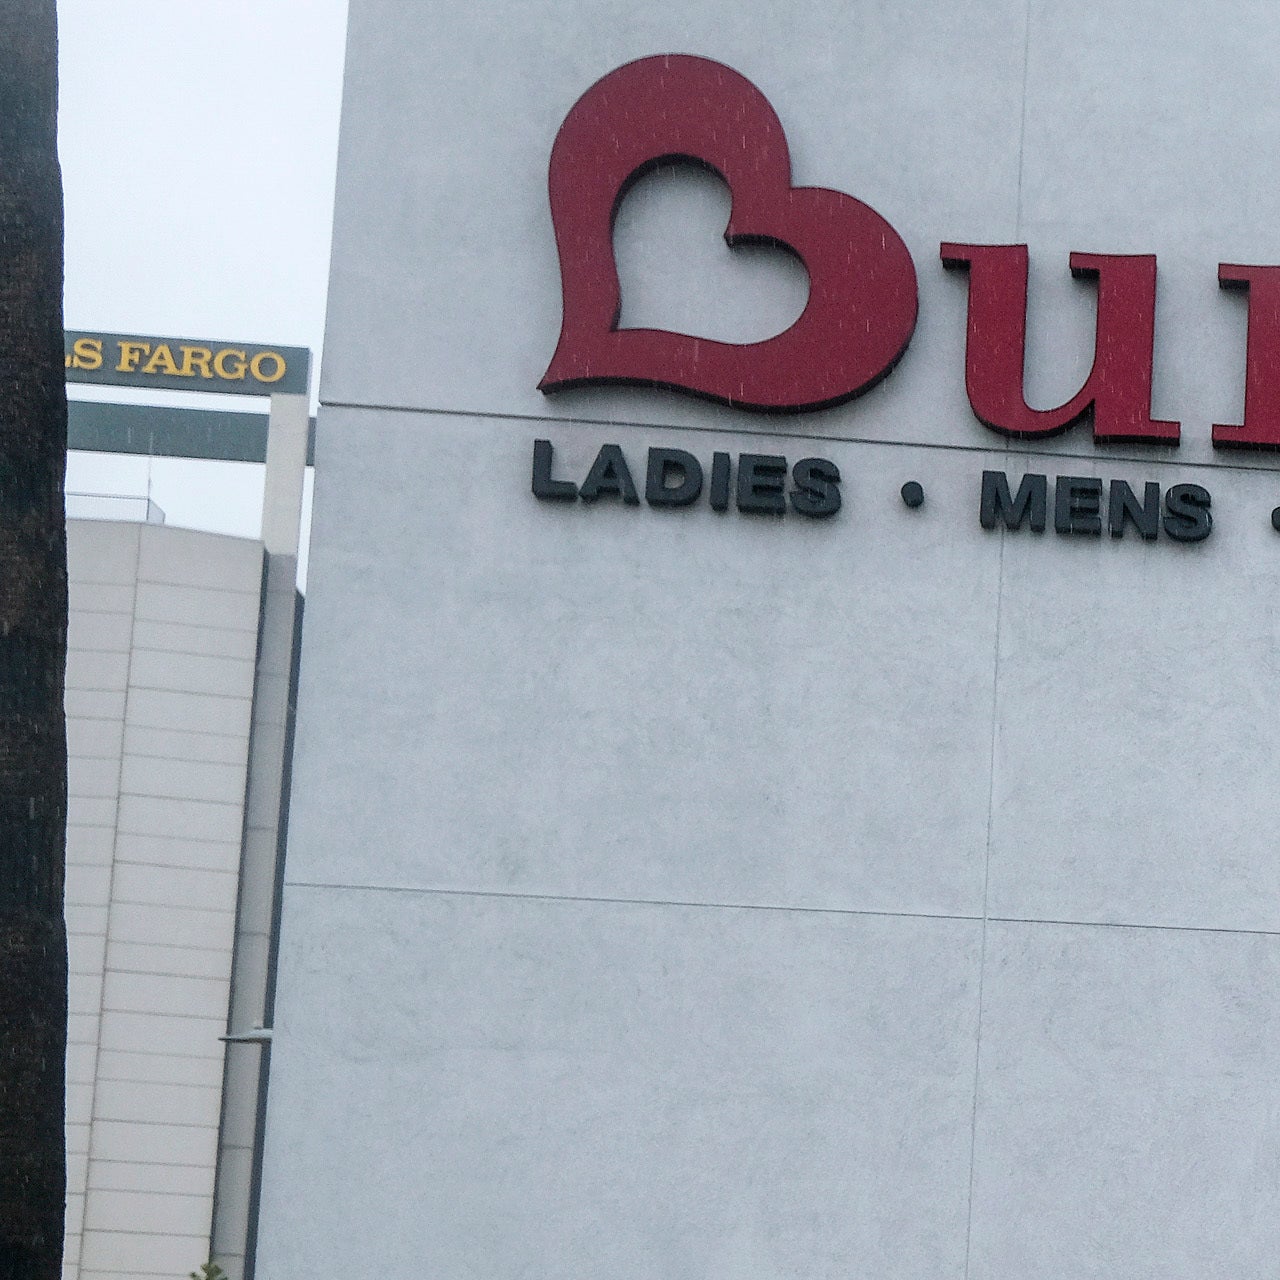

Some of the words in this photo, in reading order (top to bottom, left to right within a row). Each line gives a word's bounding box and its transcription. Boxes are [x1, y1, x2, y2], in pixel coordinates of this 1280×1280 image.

[65, 337, 102, 370] S
[116, 341, 286, 383] FARGO
[531, 439, 842, 517] LADIES
[980, 470, 1212, 541] MENS
